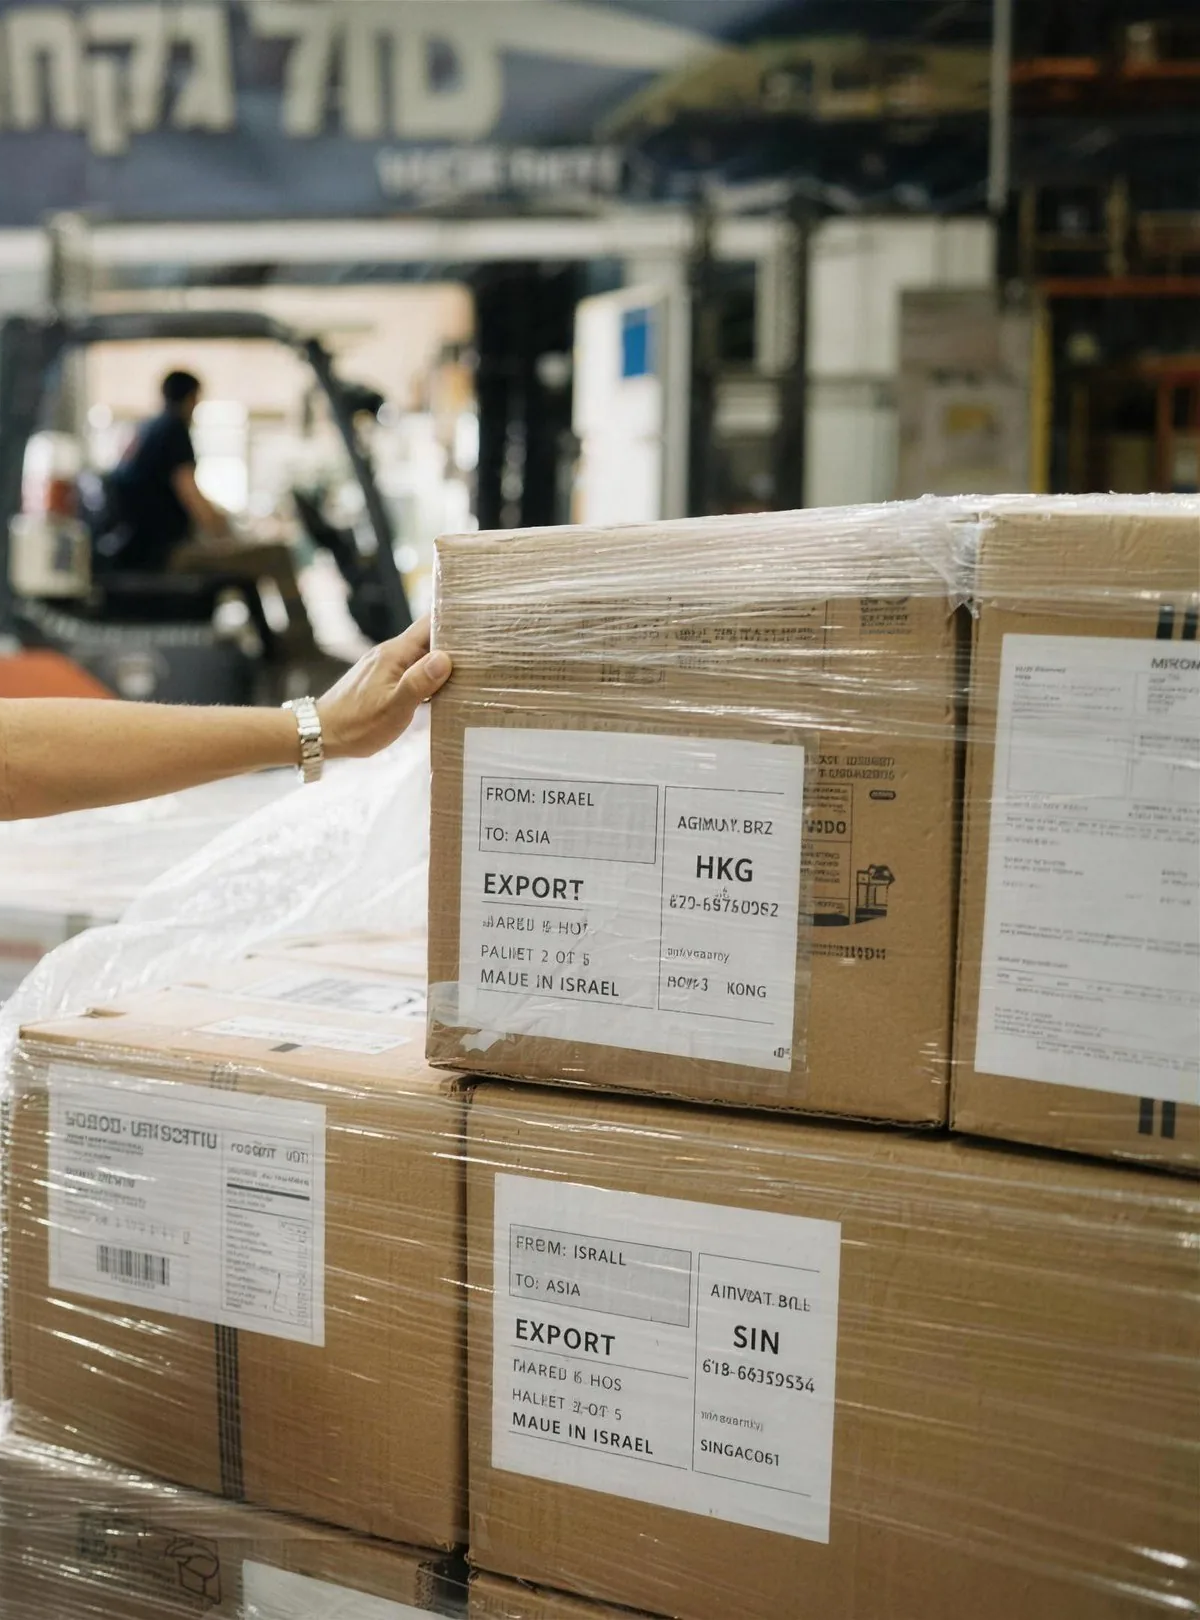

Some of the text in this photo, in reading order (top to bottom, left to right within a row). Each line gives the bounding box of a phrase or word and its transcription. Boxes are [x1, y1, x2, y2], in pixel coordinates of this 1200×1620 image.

[486, 787, 594, 806] FROM: ISRAEL
[485, 827, 550, 844] TO: ASIA
[696, 855, 753, 883] HKG
[484, 872, 584, 900] EXPORT
[536, 974, 553, 990] IN
[560, 977, 619, 996] ISRAEL
[727, 982, 766, 998] KONG
[574, 1245, 627, 1266] ISRALL
[515, 1273, 580, 1296] TO: ASIA
[516, 1318, 616, 1356] EXPORT
[733, 1325, 779, 1355] SIN
[568, 1423, 586, 1440] IN
[594, 1428, 654, 1455] ISRAEL
